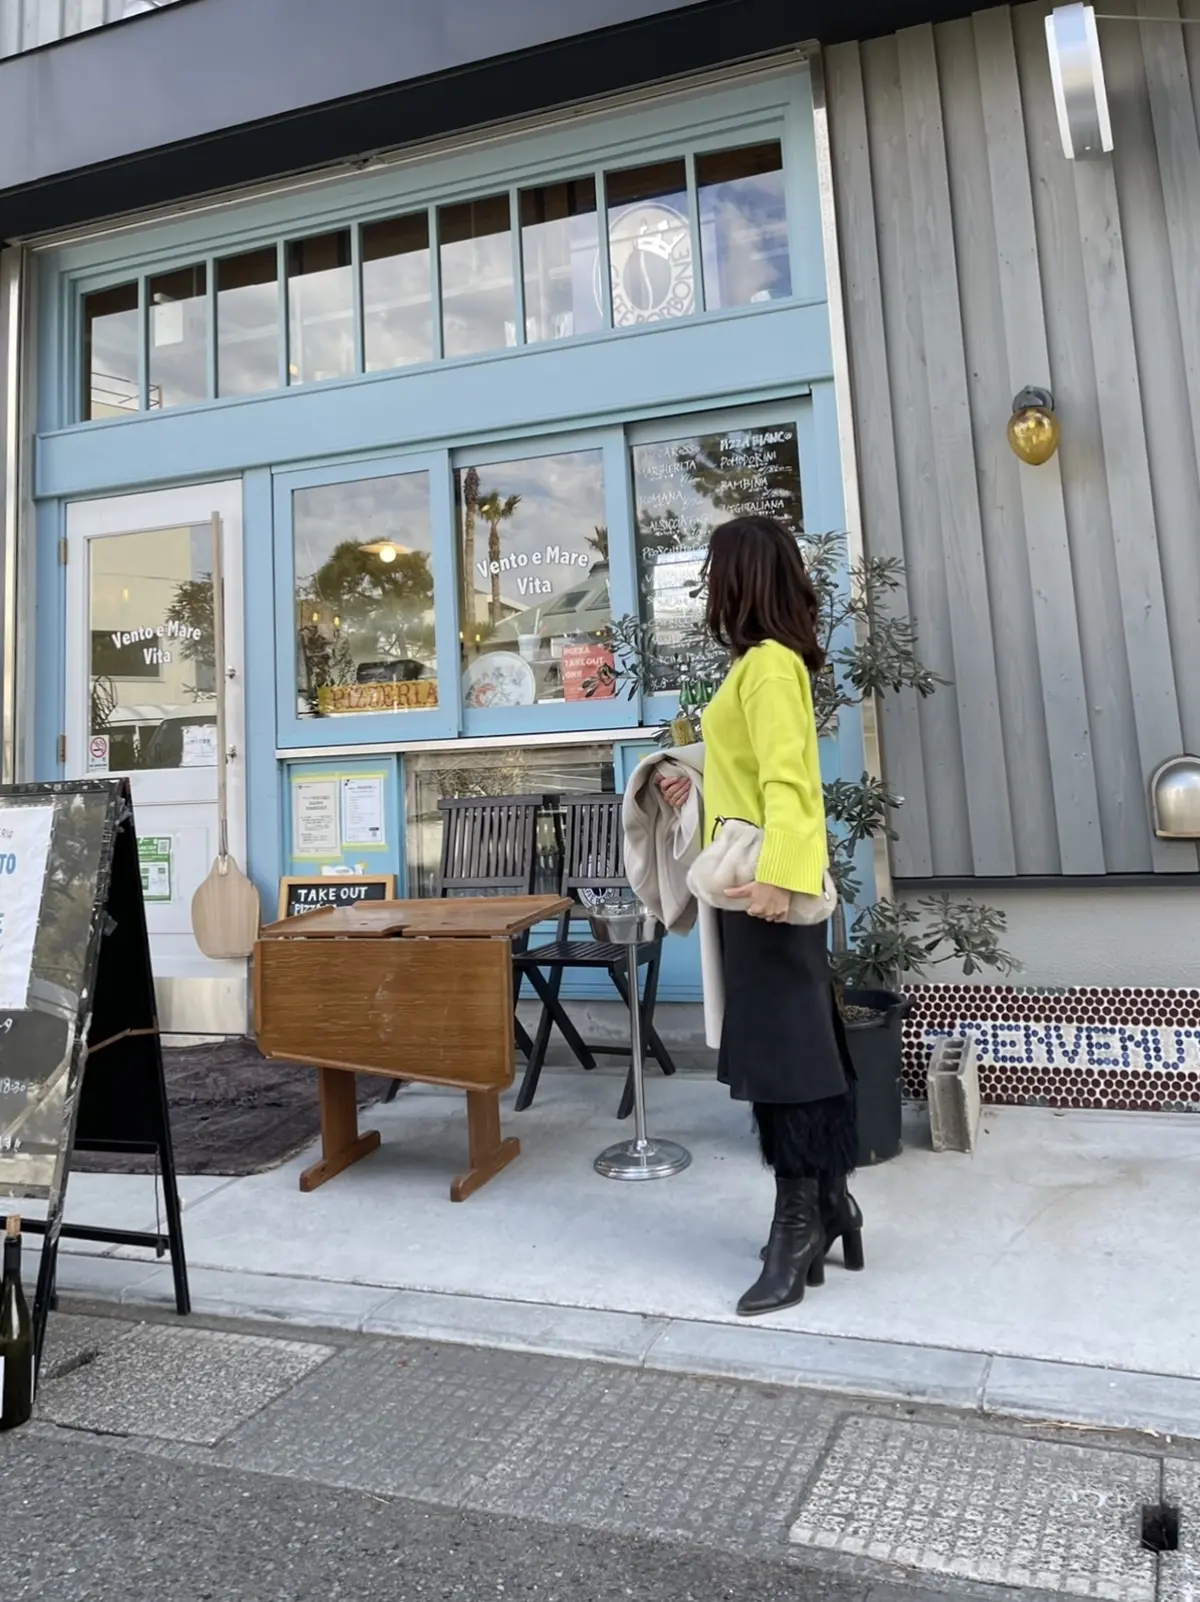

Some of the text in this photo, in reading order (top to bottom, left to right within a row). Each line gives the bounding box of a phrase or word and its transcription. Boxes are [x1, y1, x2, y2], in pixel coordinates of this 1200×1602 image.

[477, 545, 589, 578] Vento e Mare
[517, 576, 552, 595] Vita
[111, 620, 202, 649] Vento e Mare
[143, 647, 171, 665] Vita
[331, 682, 439, 710] PIZZERIA
[297, 886, 368, 902] TAKE OUT
